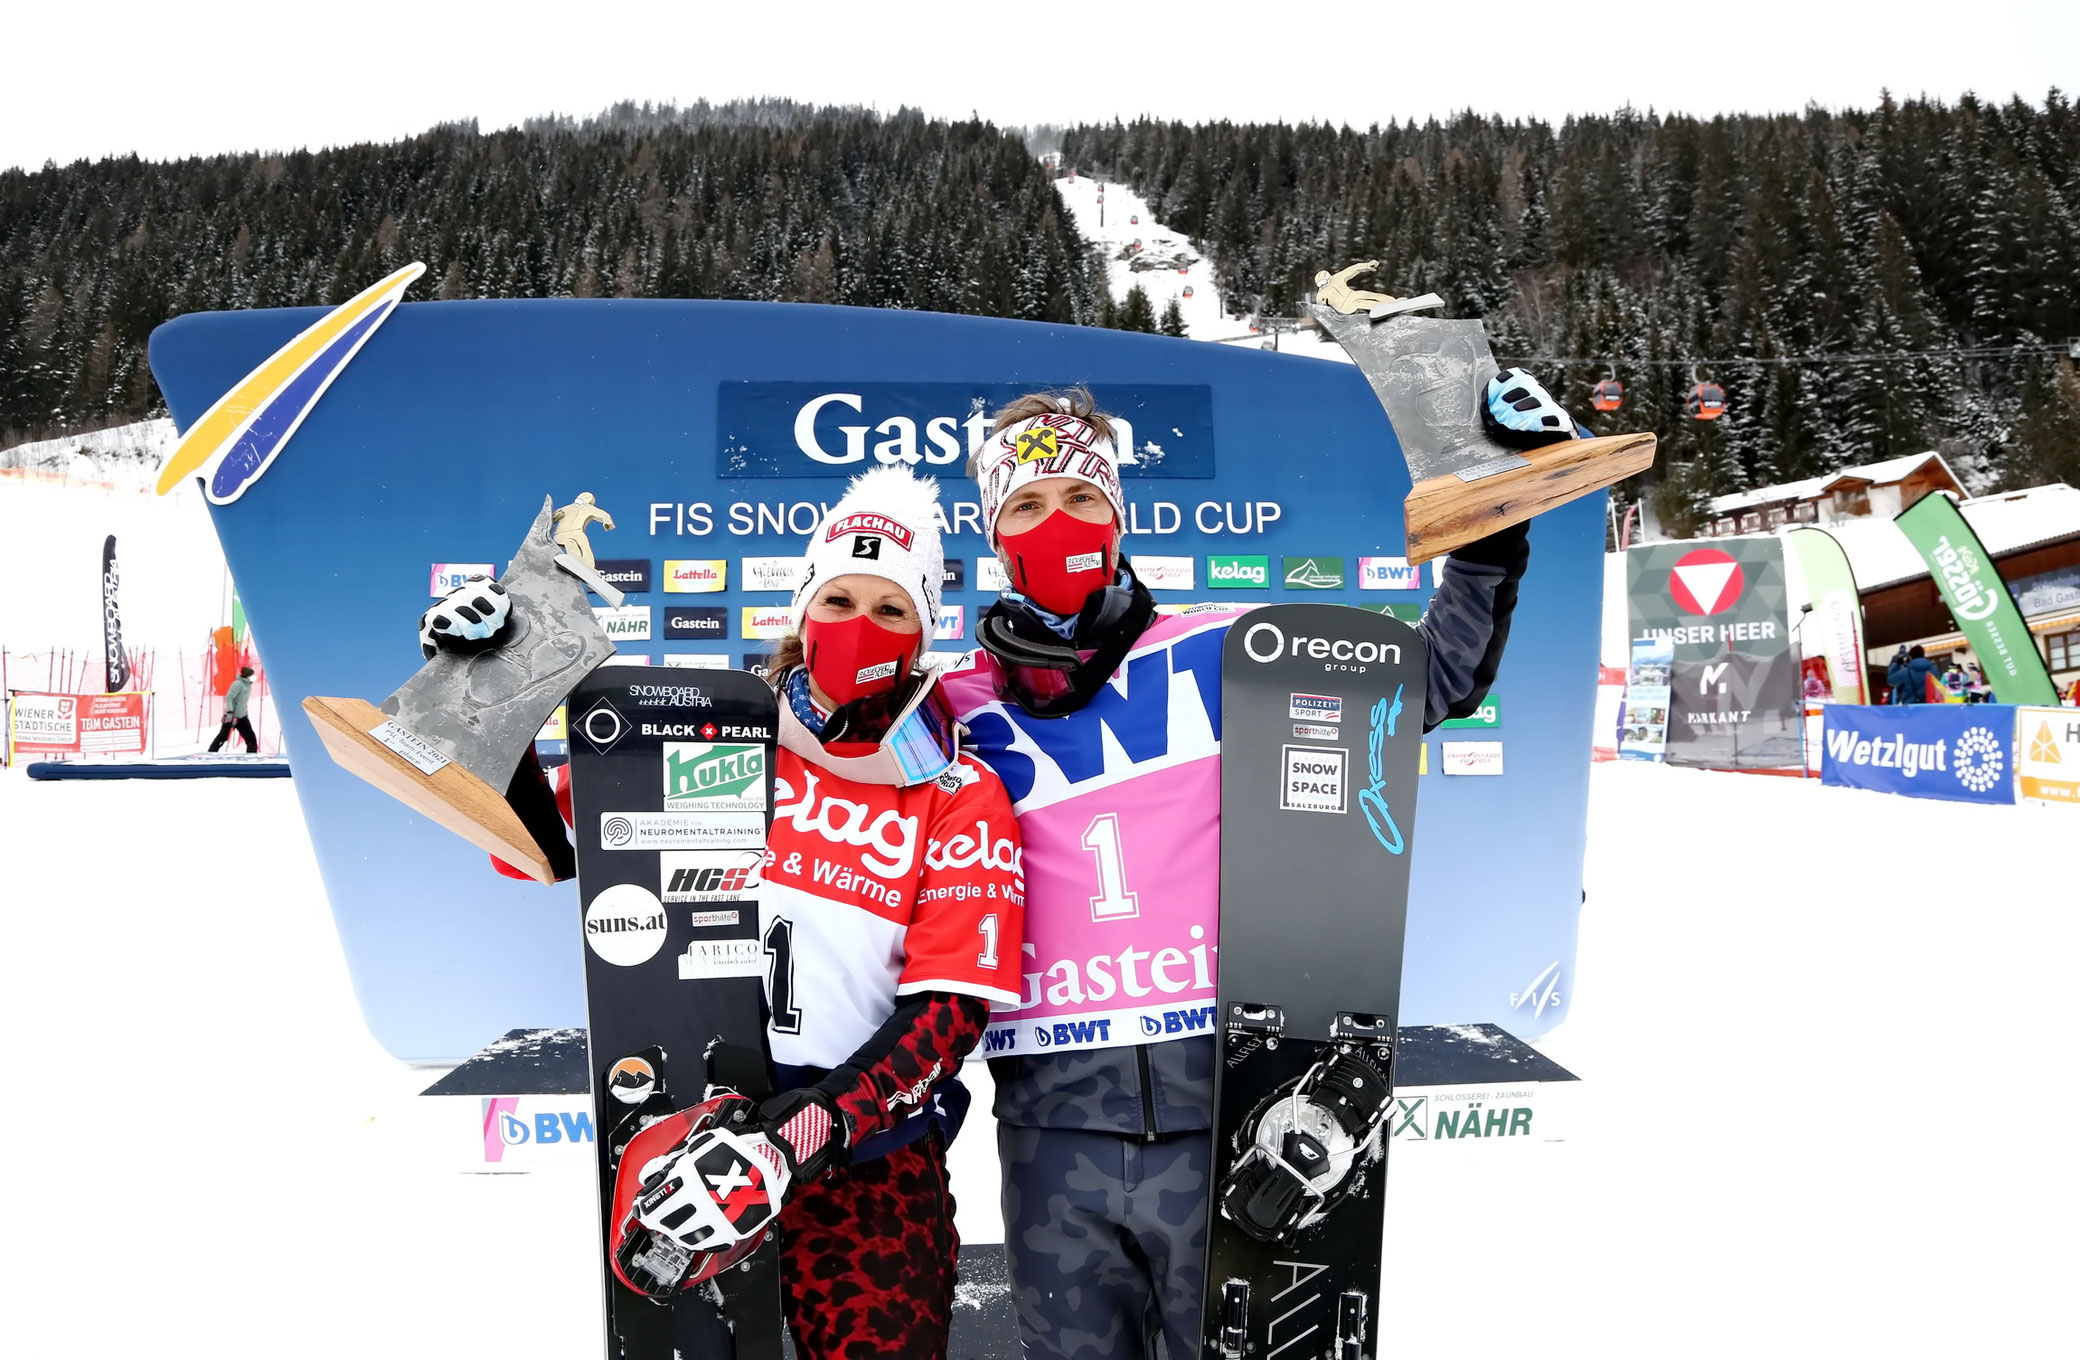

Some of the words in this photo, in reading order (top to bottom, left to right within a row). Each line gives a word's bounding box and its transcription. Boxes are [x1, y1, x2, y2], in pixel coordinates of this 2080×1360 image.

[650, 503, 711, 536] FIS
[1196, 502, 1281, 536] CUP
[835, 515, 906, 540] FLACHAU
[673, 569, 717, 580] Lattella
[1211, 559, 1266, 583] kelag
[1377, 566, 1414, 580] BWT
[606, 617, 648, 633] NÄHR
[671, 616, 720, 629] Gastein
[1720, 621, 1776, 643] HEER
[1292, 635, 1401, 665] recon
[1325, 663, 1367, 674] group
[629, 684, 700, 698] SNOWBOARD
[668, 695, 712, 708] AUSTRIA
[1295, 698, 1333, 709] POLIZEI
[15, 707, 55, 719] WIENER
[1294, 708, 1323, 718] SPORT
[1688, 710, 1751, 724] MARKANT
[14, 720, 72, 732] STÄDTISCHE
[81, 717, 101, 731] TEAM
[102, 715, 140, 730] GASTEIN
[641, 723, 696, 737] BLACK
[721, 725, 772, 739] PEARL
[1294, 726, 1332, 737] sporthilfe
[388, 721, 427, 751] GASTEIN
[428, 749, 448, 764] 2021
[399, 749, 421, 766] place
[1826, 728, 1947, 778] Wetzlgut
[1292, 762, 1338, 776] SNOW
[1291, 781, 1337, 795] SPACE
[667, 801, 710, 810] WEIGHING
[711, 801, 765, 810] TECHNOLOGY
[1291, 802, 1337, 811] SALZBURG
[640, 818, 689, 827] AKADEMIE
[640, 836, 748, 845] www.neuromentaltraining.com
[1081, 812, 1140, 923] 1
[813, 858, 902, 908] Wärme
[663, 894, 688, 902] SERVICE
[689, 894, 697, 902] IN
[699, 893, 709, 902] THE
[711, 893, 725, 902] FAST
[727, 893, 741, 902] LANE
[917, 881, 982, 905] Energie
[986, 883, 998, 898] &
[587, 911, 667, 935] suns.at
[976, 913, 999, 970] 1
[1053, 1019, 1111, 1045] BWT
[1226, 1035, 1264, 1069] ALLFLEX
[1434, 1091, 1490, 1102] SCHLOSSEREI
[1495, 1090, 1534, 1098] ZAUNBAU
[534, 1111, 594, 1144] BW
[1434, 1102, 1534, 1140] NÄHR
